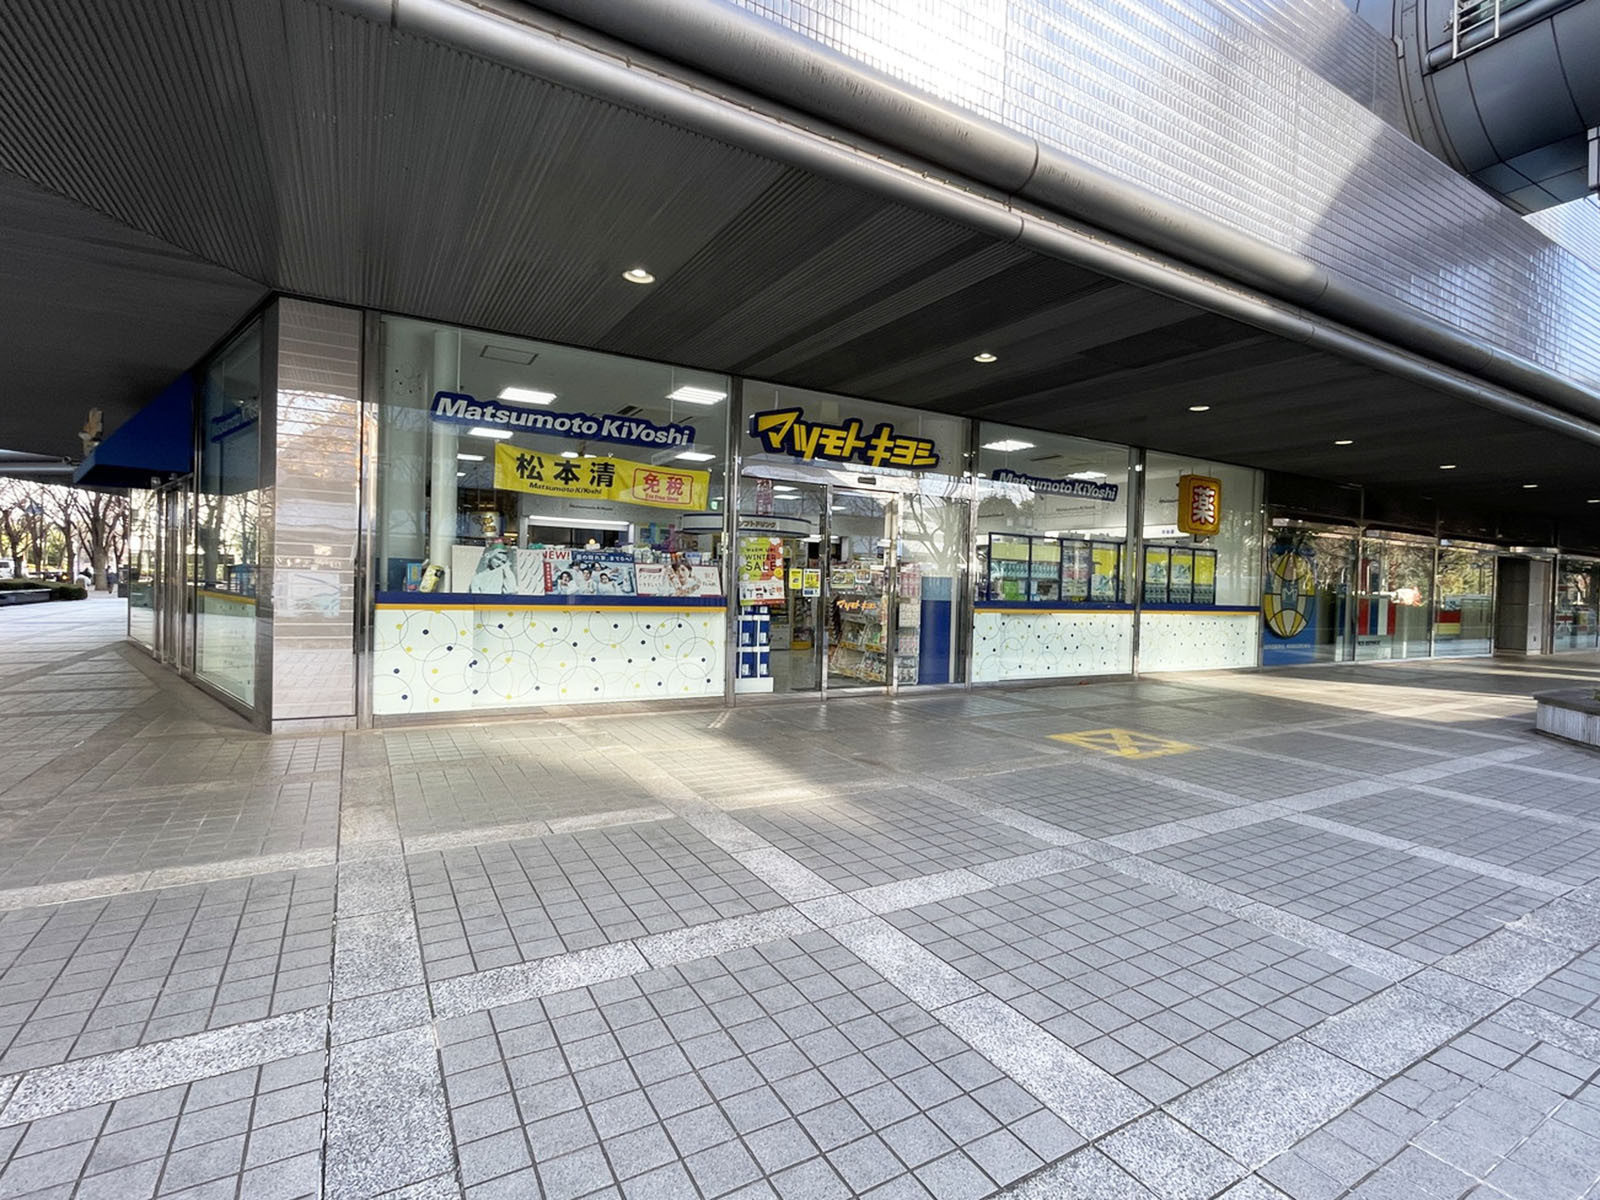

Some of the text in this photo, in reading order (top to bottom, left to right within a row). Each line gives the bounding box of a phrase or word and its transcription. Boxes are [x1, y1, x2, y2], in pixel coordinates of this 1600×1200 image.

[436, 397, 691, 447] Matsumoto KiYoshi
[757, 411, 937, 468] マツモトキヨシ
[515, 452, 616, 489] 松本清
[643, 471, 685, 497] 免税
[528, 482, 575, 494] Matsumoto
[999, 471, 1117, 500] Matsumoto KiYoshi
[1192, 485, 1216, 524] 薬
[744, 553, 777, 561] WINTER
[745, 561, 777, 572] SALE
